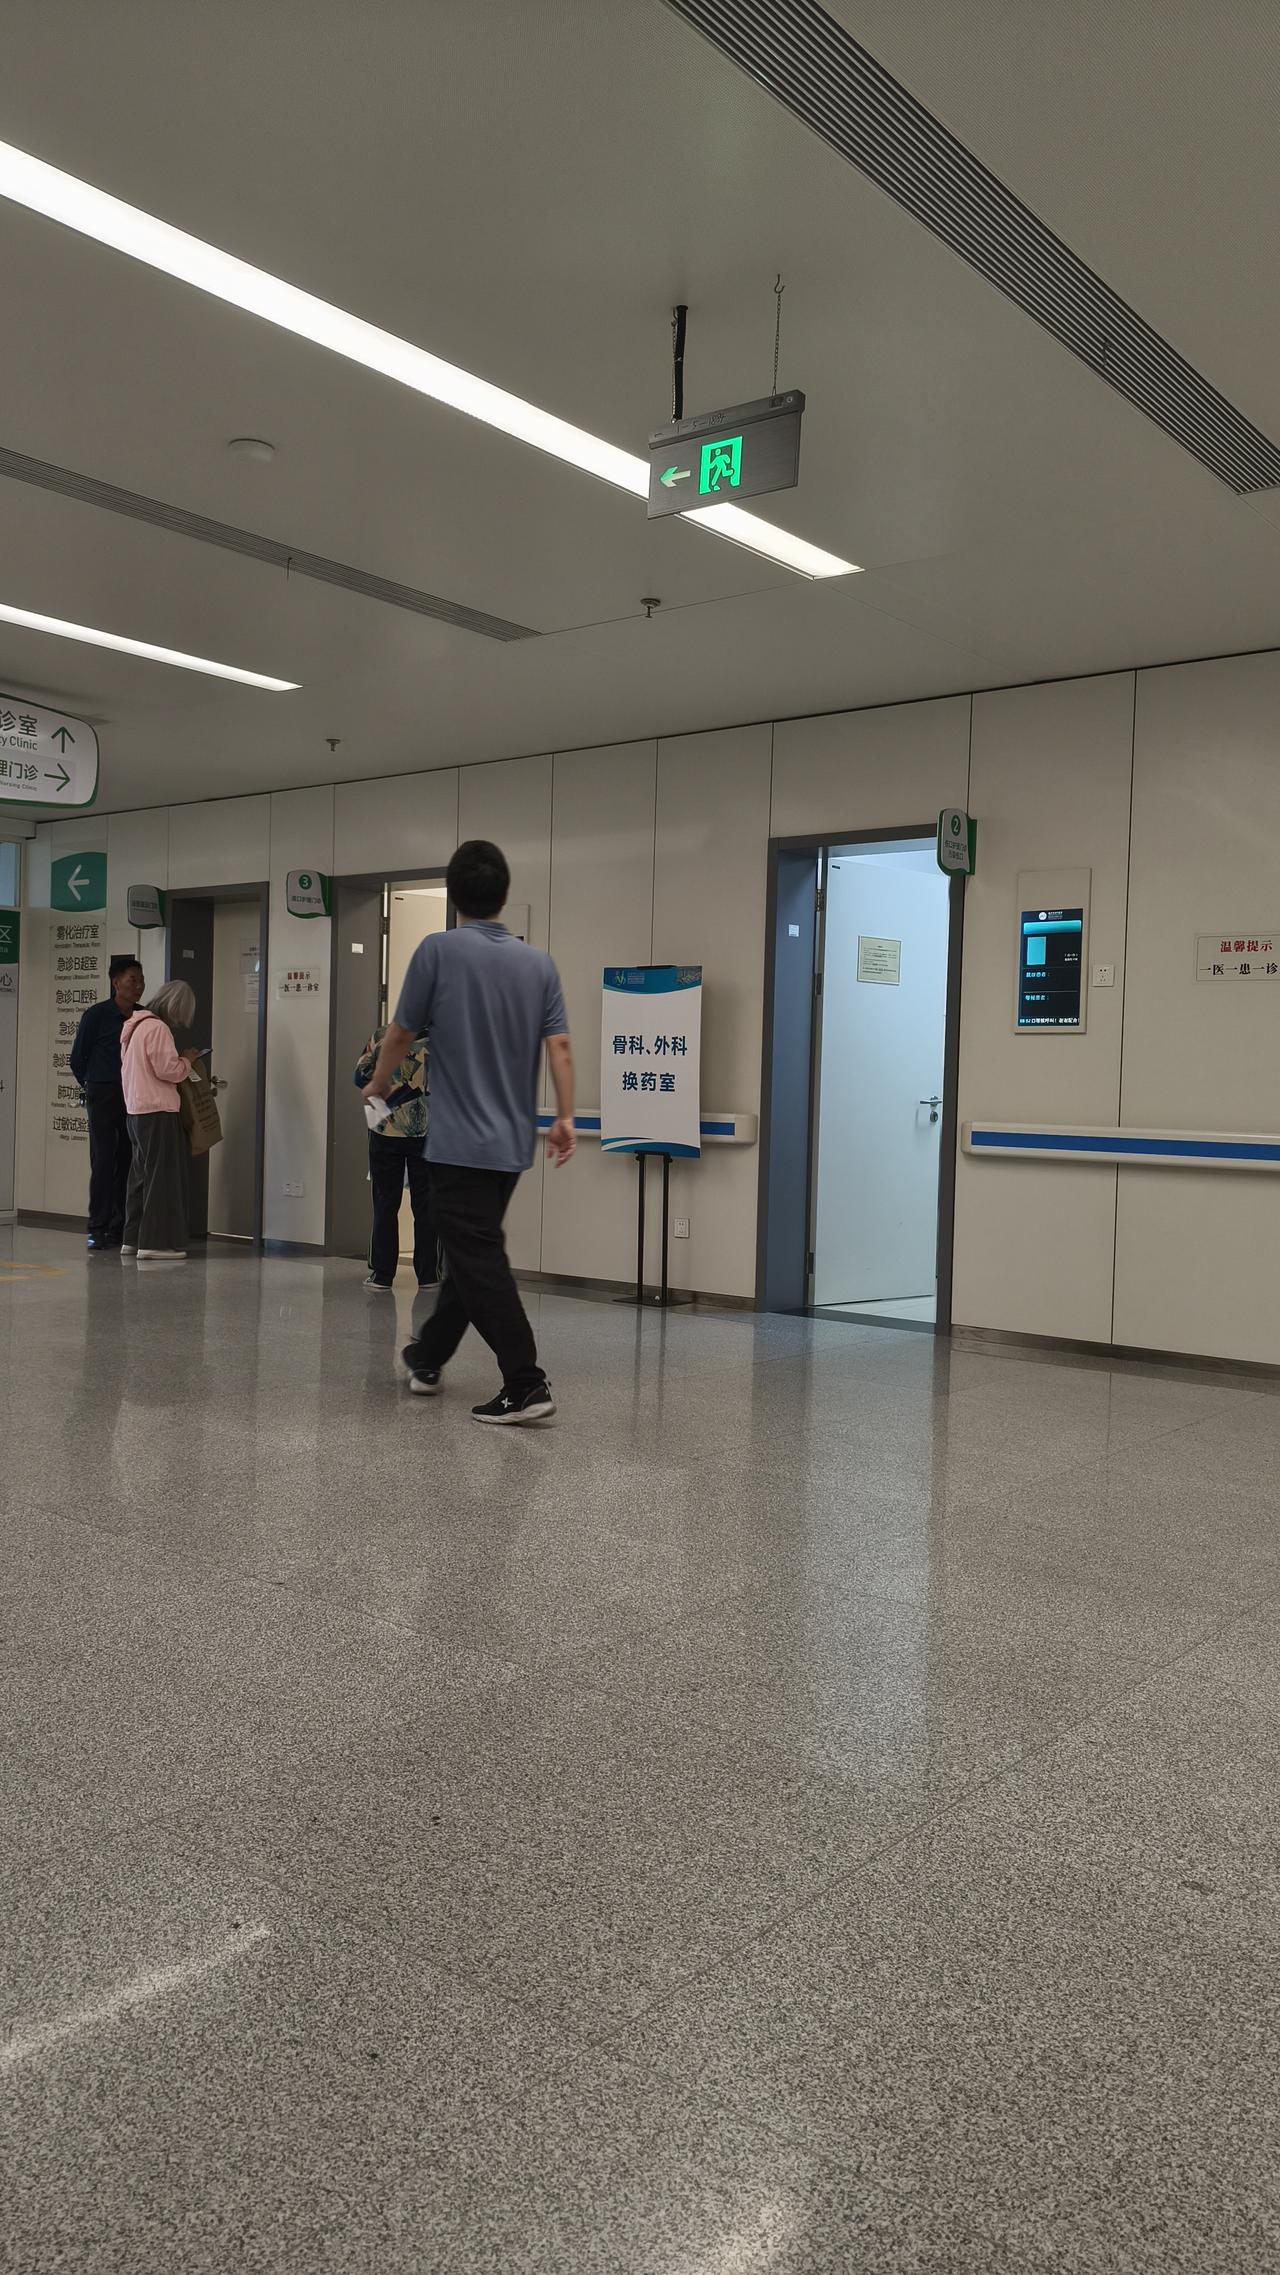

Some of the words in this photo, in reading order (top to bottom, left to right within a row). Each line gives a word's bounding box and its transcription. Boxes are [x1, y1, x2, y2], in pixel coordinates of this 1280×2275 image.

[0, 710, 38, 737] 诊室
[9, 736, 38, 751] Clinic
[57, 924, 99, 940] 雾化治疗室
[1220, 940, 1273, 952] 温馨提示
[56, 956, 98, 972] 急诊B超室
[1200, 963, 1280, 975] 一医一患一诊
[56, 989, 97, 1004] 急诊口腔科
[59, 1021, 79, 1036] 急诊
[612, 1035, 688, 1056] 骨科、外科
[622, 1071, 676, 1092] 换药室
[52, 1116, 90, 1132] 过敏试验
